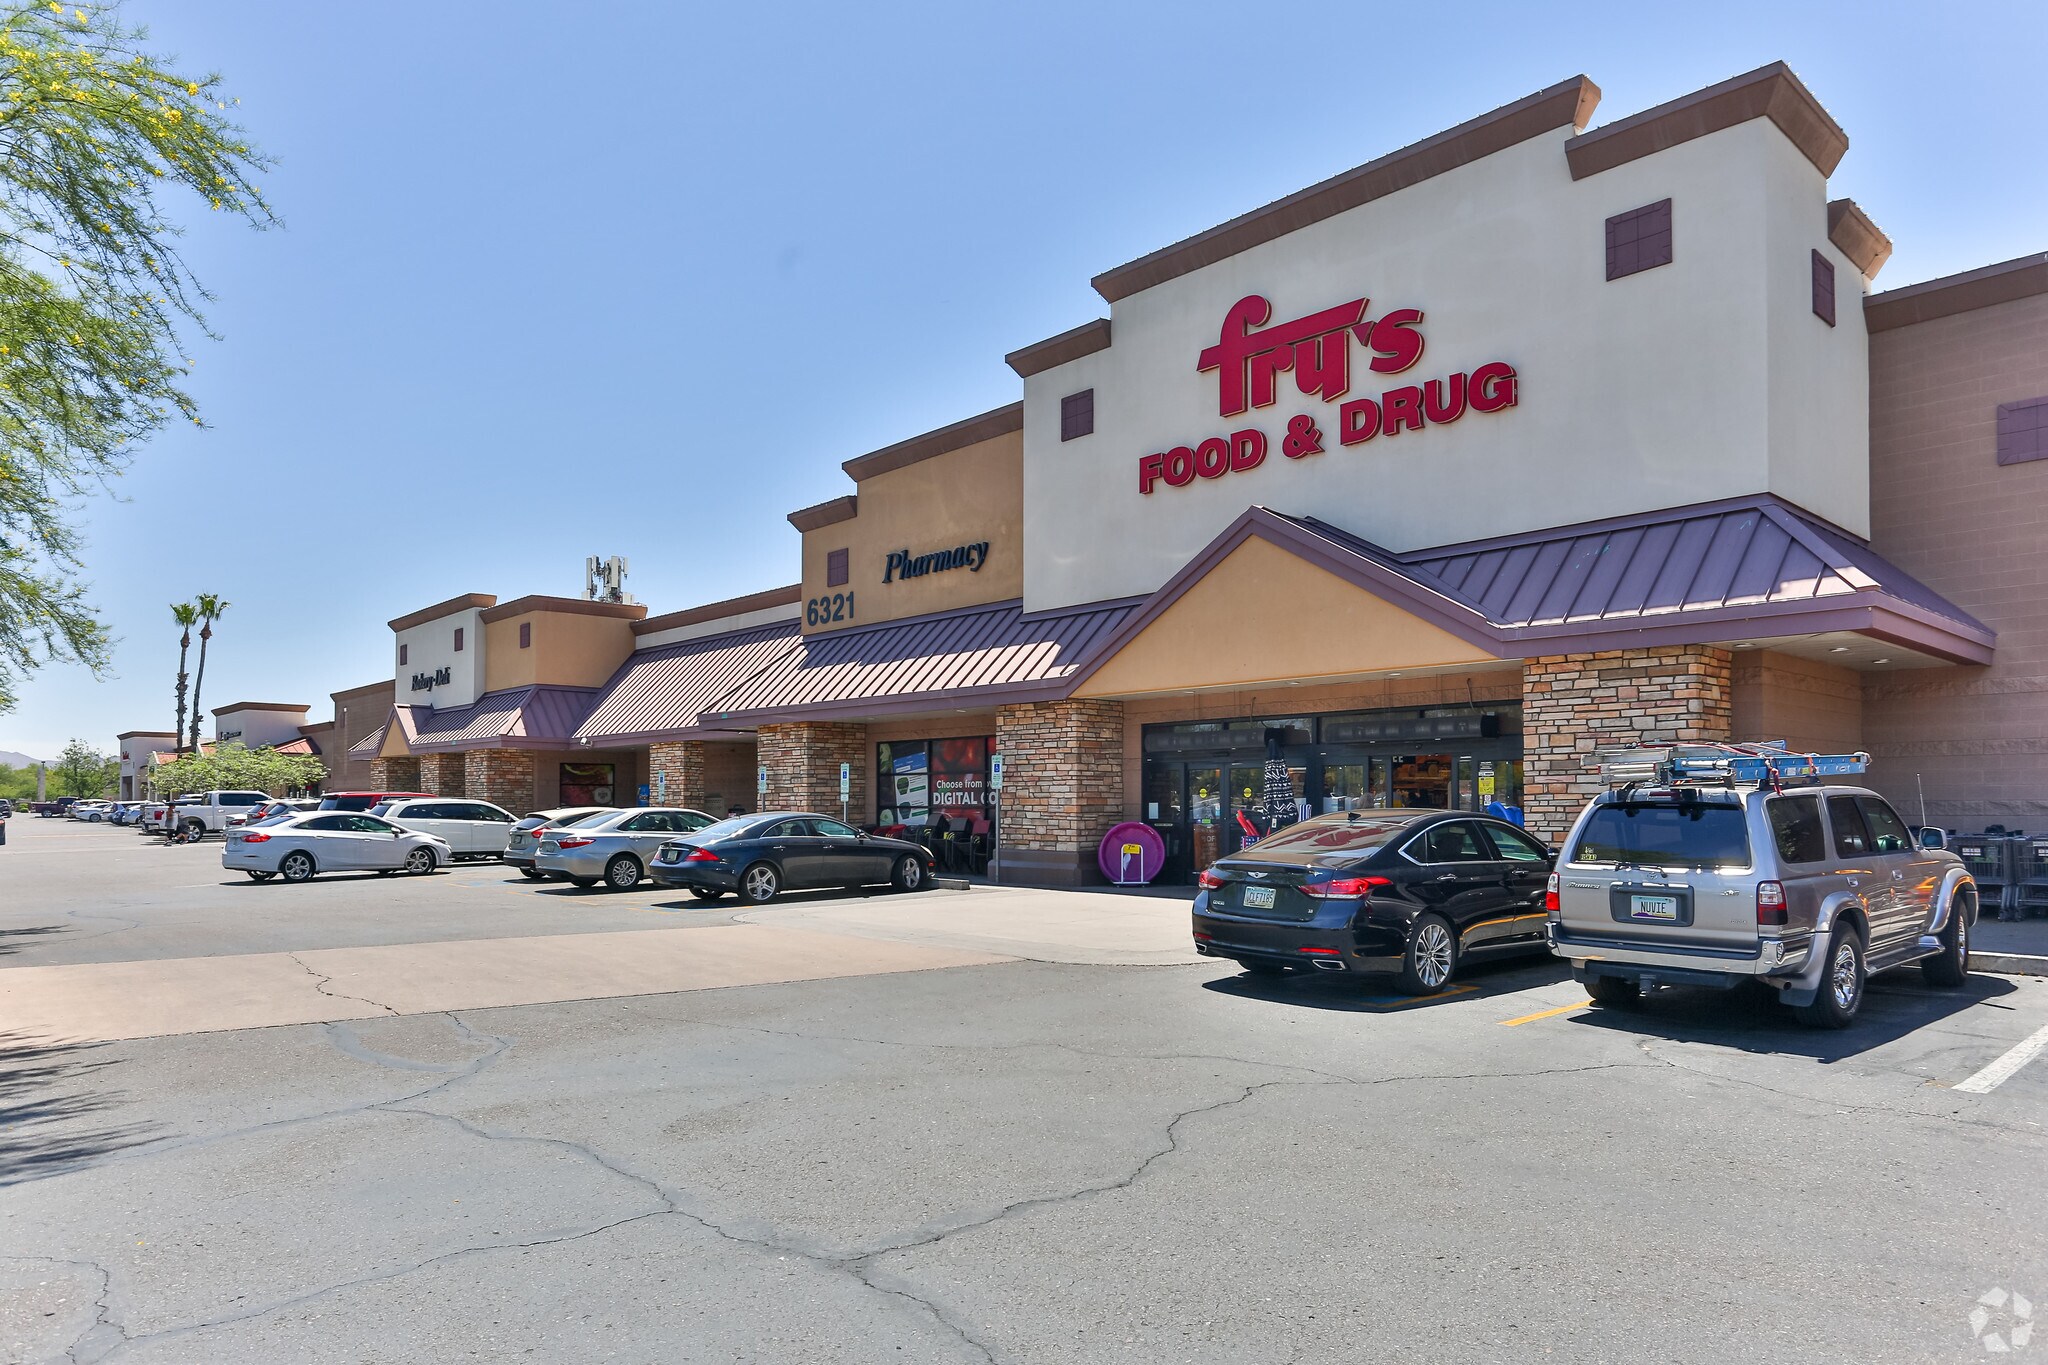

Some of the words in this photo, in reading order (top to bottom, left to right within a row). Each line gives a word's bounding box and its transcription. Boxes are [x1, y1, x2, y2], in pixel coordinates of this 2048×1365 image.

[1138, 428, 1268, 495] FOOD
[1281, 413, 1325, 460] &
[1339, 361, 1518, 446] DRUG
[881, 541, 990, 584] Pharmacy
[806, 591, 855, 627] 6321
[936, 780, 963, 789] Choose
[964, 780, 983, 788] from
[933, 791, 978, 805] DIGITAL
[1640, 901, 1667, 913] NUVIE
